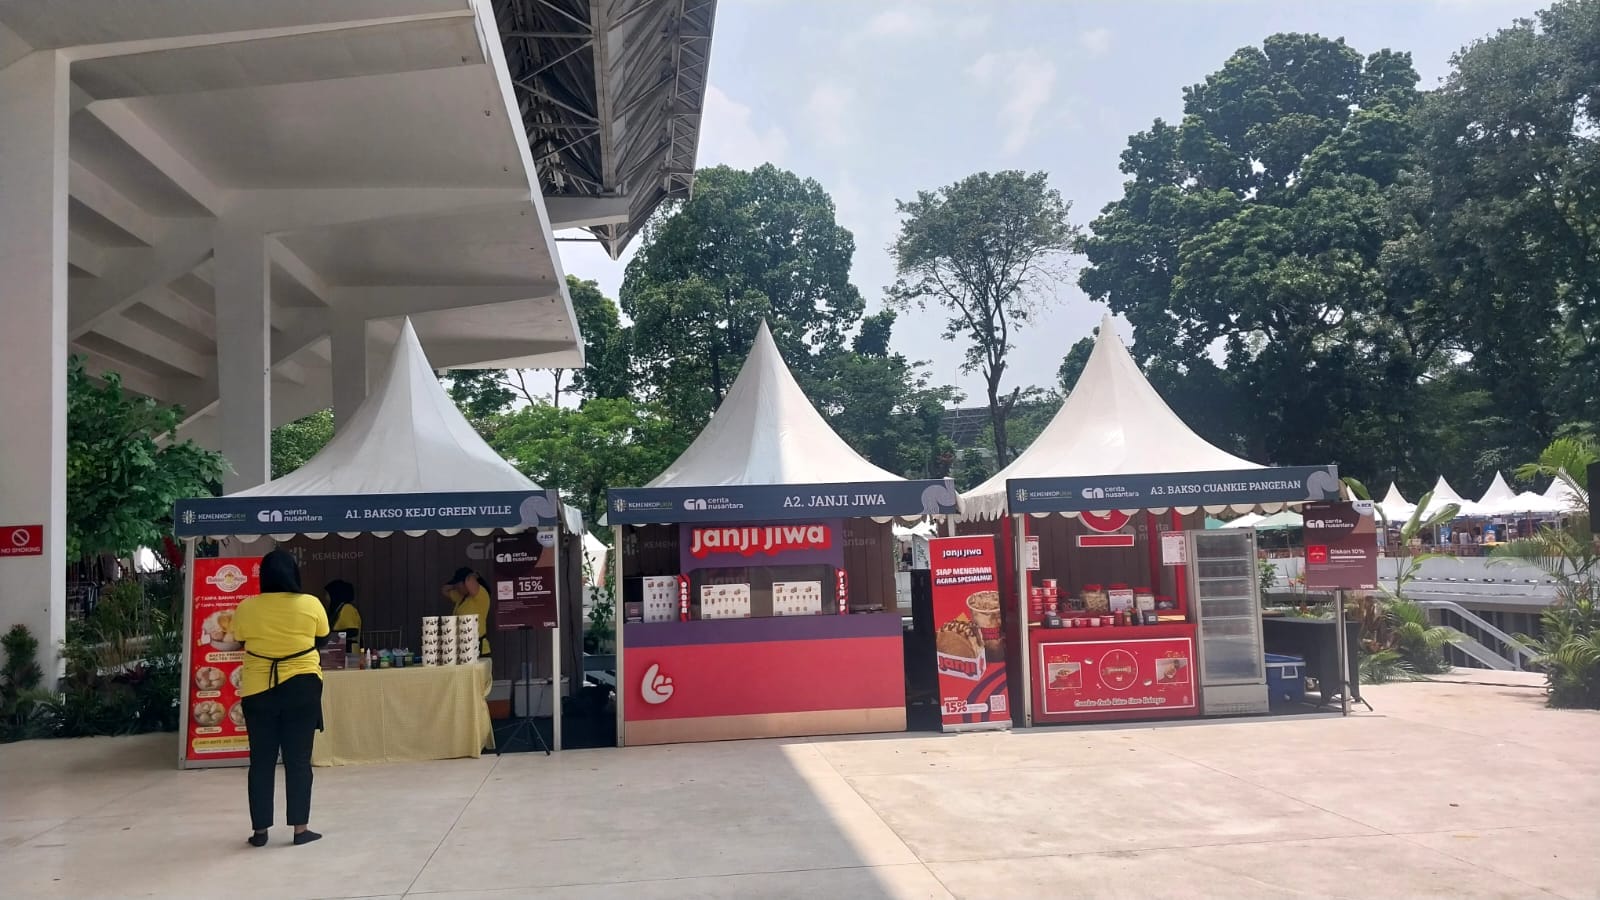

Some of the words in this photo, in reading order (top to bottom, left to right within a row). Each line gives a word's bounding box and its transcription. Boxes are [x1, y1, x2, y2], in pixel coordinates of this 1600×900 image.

[1150, 486, 1166, 496] A3.
[1167, 484, 1201, 495] BAKSO
[1203, 483, 1247, 493] CUANKIE
[1249, 480, 1301, 491] PANGERAN
[708, 502, 744, 510] nusantara
[783, 496, 804, 508] A2.
[807, 495, 849, 508] JANJI
[851, 494, 886, 506] JIWA
[345, 509, 361, 519] A1.
[364, 508, 403, 519] BAKSO
[405, 507, 436, 518] KEJU
[438, 505, 477, 517] GREEN
[479, 505, 512, 515] VILLE
[692, 526, 758, 552] janji
[763, 525, 825, 550] jiwa
[312, 551, 364, 561] KEMENKOP
[943, 549, 962, 558] janji
[963, 548, 982, 557] jiwa
[936, 568, 952, 576] SIAP
[518, 581, 543, 592] 15%
[839, 599, 846, 611] UP
[945, 701, 968, 713] 15%
